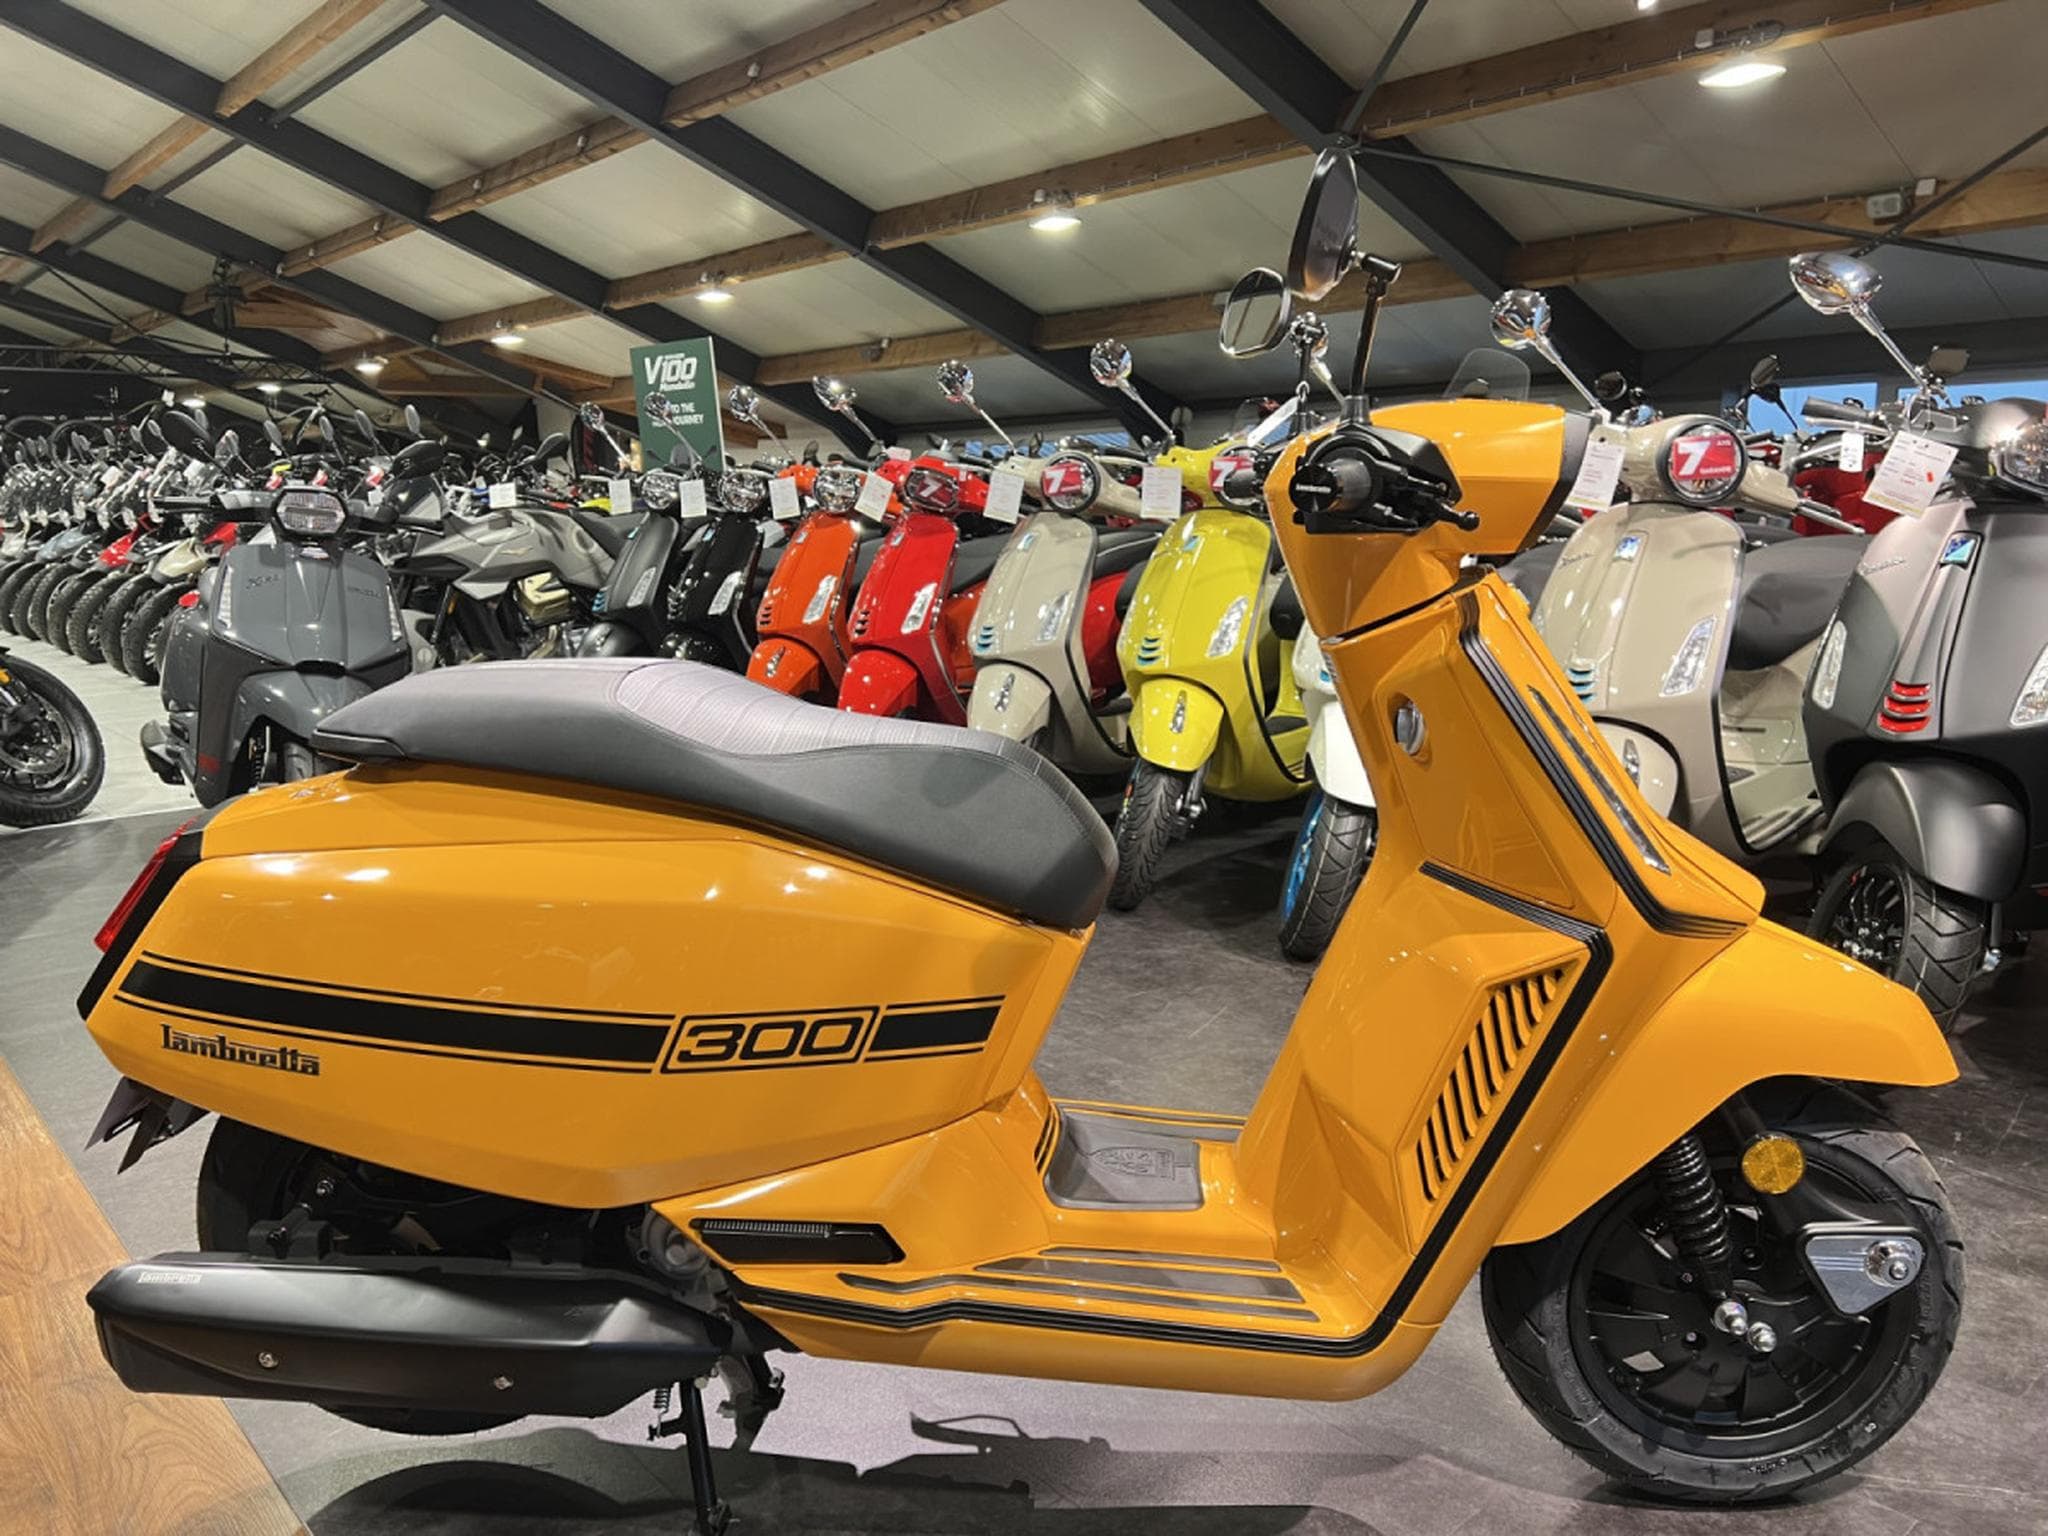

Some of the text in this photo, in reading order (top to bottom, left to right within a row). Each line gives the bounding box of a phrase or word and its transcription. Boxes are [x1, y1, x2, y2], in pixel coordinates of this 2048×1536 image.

[644, 355, 697, 384] V100
[680, 402, 695, 413] THE
[1678, 441, 1710, 476] 7
[1045, 469, 1066, 493] 7
[1210, 460, 1237, 487] 7
[919, 478, 942, 497] 7
[677, 1016, 864, 1063] 300
